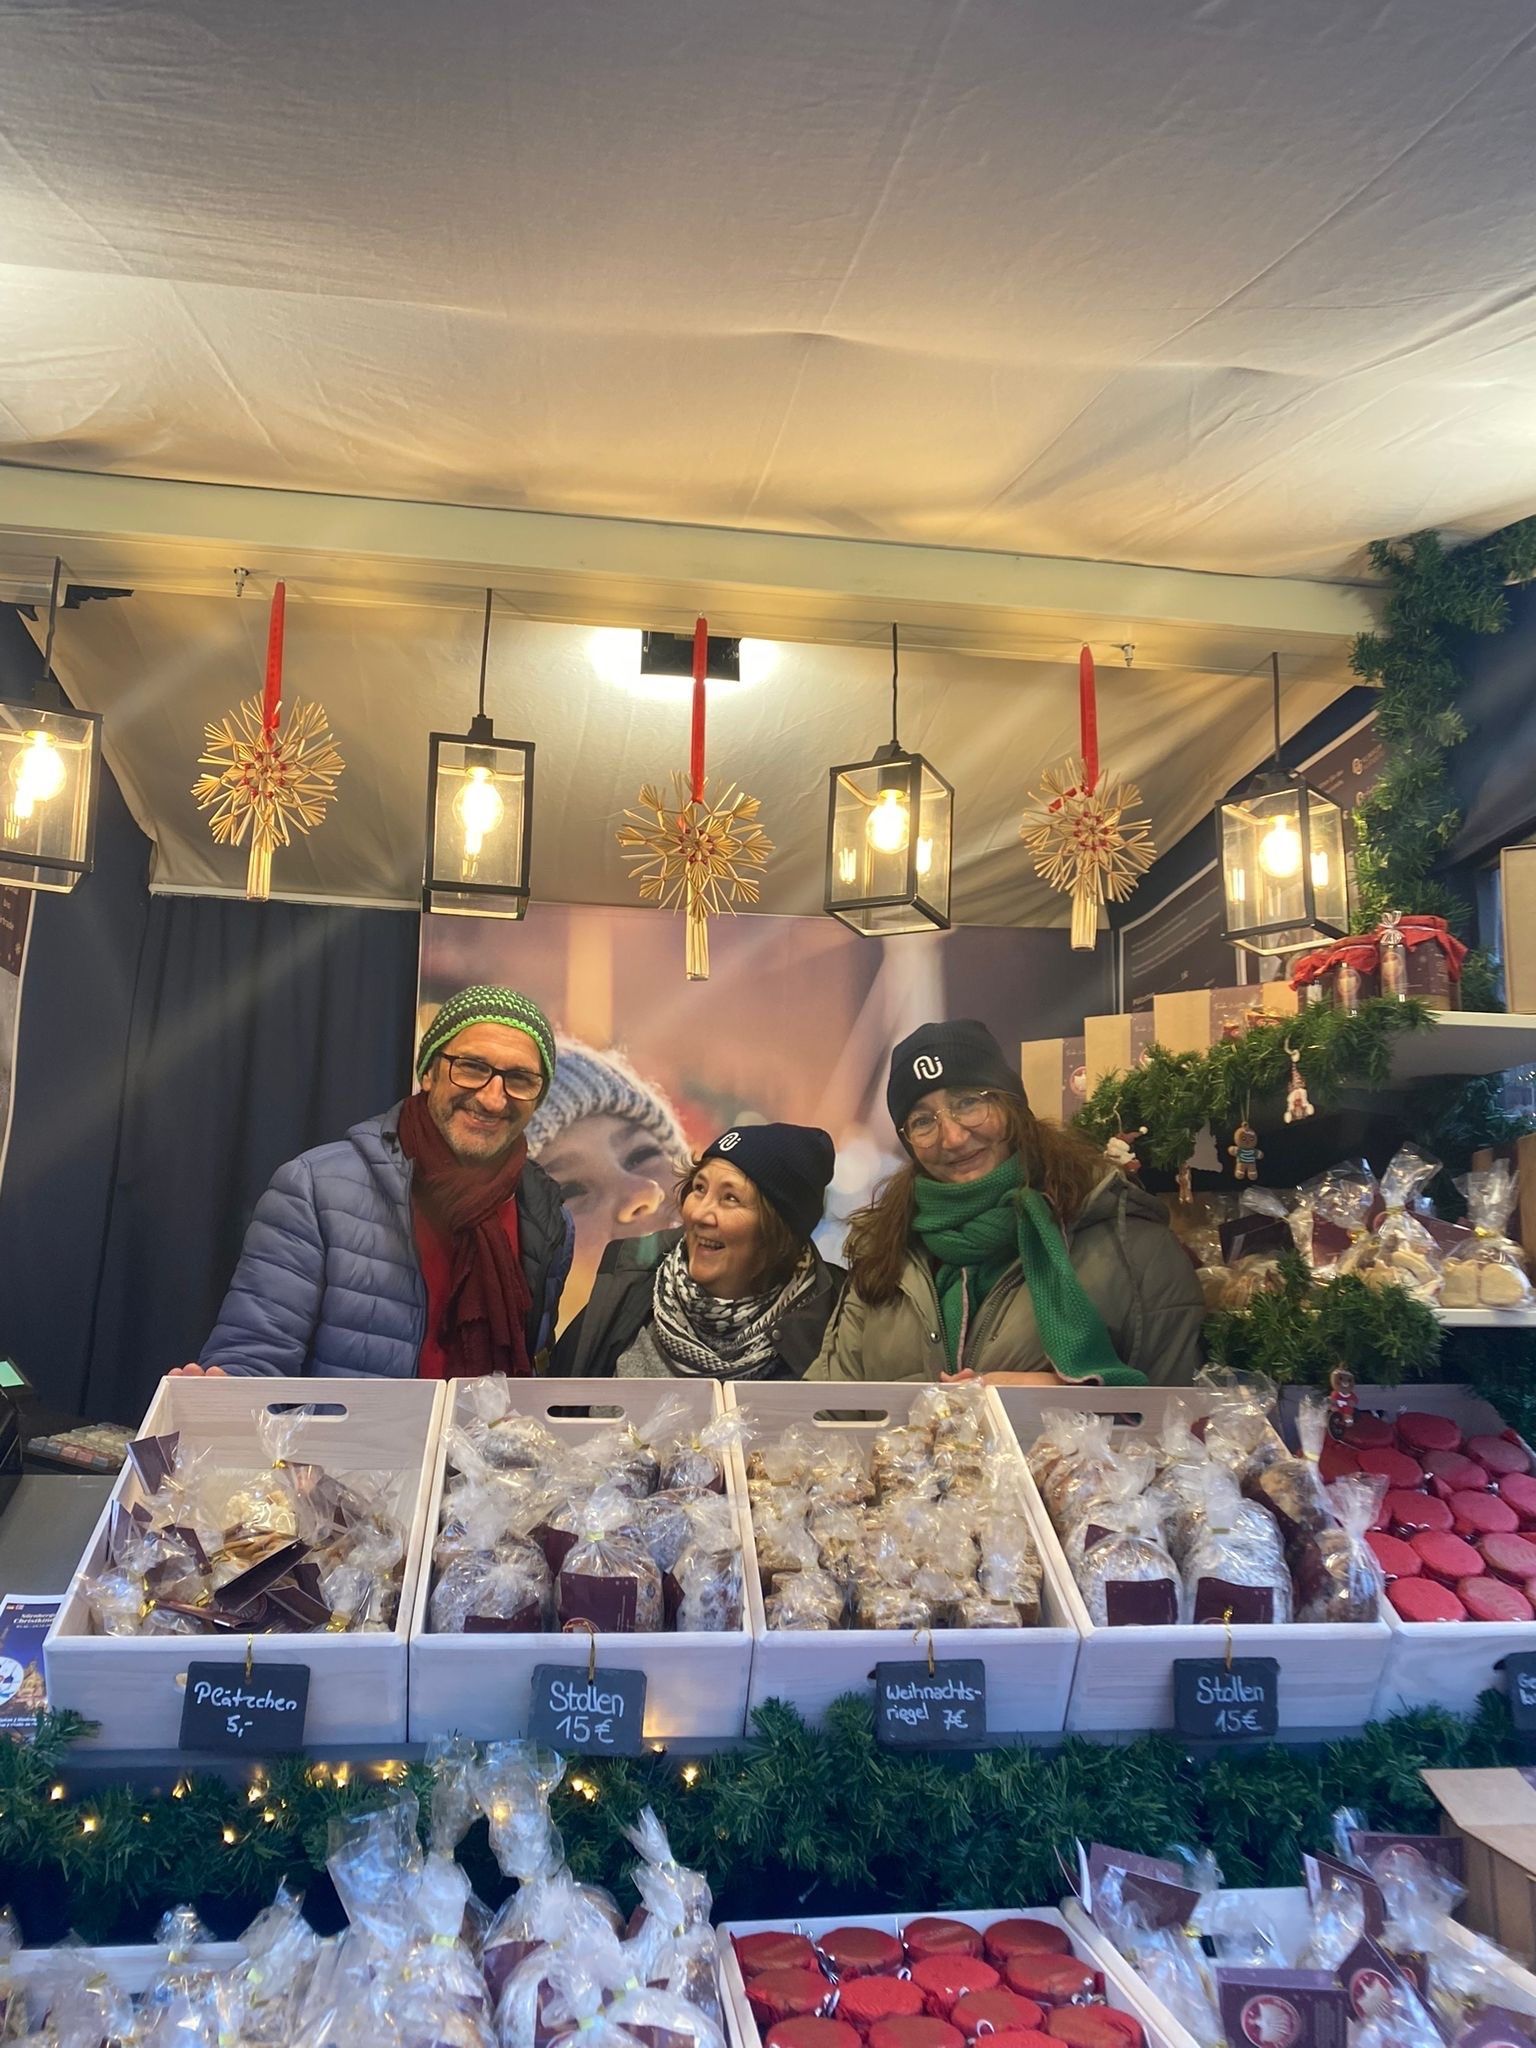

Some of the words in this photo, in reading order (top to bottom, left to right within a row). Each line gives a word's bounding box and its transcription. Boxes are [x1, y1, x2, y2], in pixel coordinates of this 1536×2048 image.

[194, 1681, 297, 1711] Plätzchen
[549, 1680, 624, 1718] Stollen
[886, 1678, 982, 1701] Weihnachts-
[1196, 1674, 1265, 1705] Stollen
[886, 1701, 930, 1726] riegel
[942, 1709, 969, 1731] 7€
[1214, 1709, 1263, 1733] 15€
